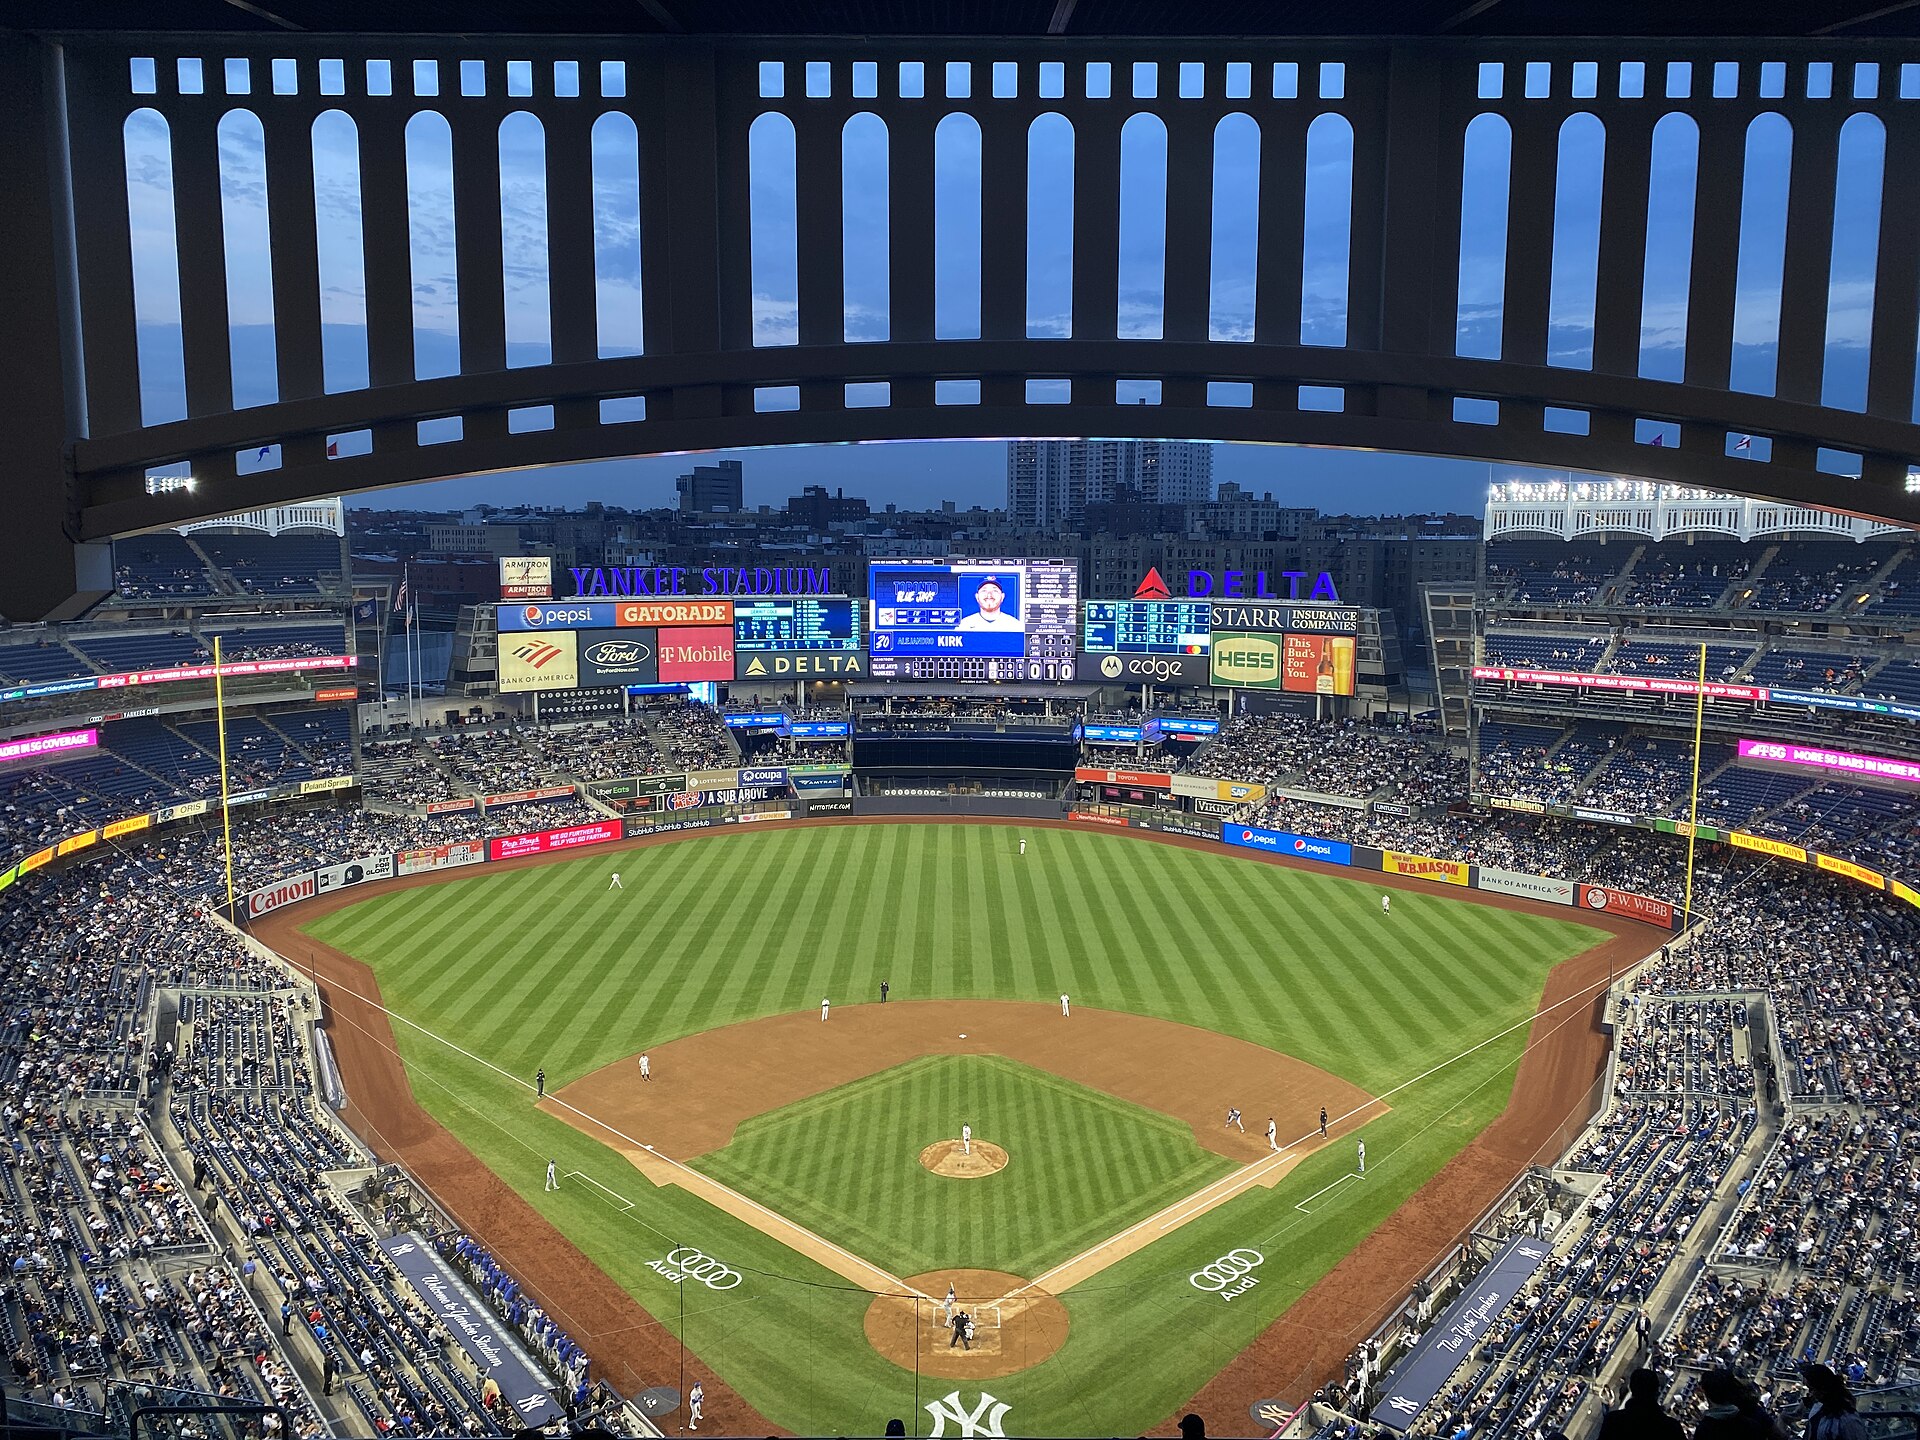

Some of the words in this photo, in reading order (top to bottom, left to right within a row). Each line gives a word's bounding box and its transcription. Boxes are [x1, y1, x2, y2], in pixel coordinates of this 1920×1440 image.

[567, 567, 687, 596] YANKEE
[702, 567, 830, 595] STADIUM
[893, 581, 939, 596] TORONTO
[1188, 570, 1339, 601] DELTA
[896, 591, 915, 602] BLUE
[916, 591, 935, 602] JAYS
[546, 607, 592, 624] pepsi
[624, 605, 726, 623] GATORADE
[1090, 610, 1096, 618] 0
[1106, 610, 1113, 618] 0
[1212, 607, 1284, 628] STARR
[1292, 610, 1358, 622] INSURANCE
[1292, 619, 1357, 630] COMPANIES
[876, 635, 890, 650] 30
[897, 637, 934, 646] ALEJANDRO
[938, 636, 963, 648] KIRK
[1288, 638, 1311, 648] This
[596, 644, 638, 662] Ford
[678, 646, 732, 662] Mobile
[1218, 651, 1274, 669] HESS
[1288, 648, 1316, 658] Bud's
[258, 662, 294, 670] DOWNLOAD
[776, 656, 861, 673] DELTA
[1128, 656, 1182, 682] edge
[1288, 659, 1304, 668] For
[1031, 664, 1040, 678] 0
[1048, 664, 1054, 678] 1
[1062, 664, 1071, 679] 0
[1288, 668, 1309, 678] You.
[500, 676, 524, 684] BANK
[538, 674, 574, 682] AMERICA
[1596, 678, 1618, 686] GREAT
[1620, 680, 1648, 688] OFFERS.
[1650, 682, 1694, 691] DOWNLOAD
[1726, 688, 1753, 696] TODAY.
[123, 710, 146, 718] YANKEES
[146, 708, 159, 716] CLUB
[21, 744, 30, 754] IN
[30, 740, 42, 752] 5G
[42, 734, 88, 750] COVERAGE
[1769, 746, 1786, 758] 5G
[1794, 750, 1824, 763] MORE
[1824, 754, 1838, 764] 5G
[1839, 756, 1864, 769] BARS
[1865, 761, 1876, 771] IN
[1878, 762, 1907, 776] MORE
[754, 770, 782, 780] coupa
[304, 782, 327, 792] Poland
[328, 779, 350, 790] Spring
[596, 788, 612, 796] Uber
[612, 786, 630, 794] Eats
[1231, 788, 1247, 797] SAP
[253, 792, 268, 800] TEA
[674, 791, 699, 801] Jersey
[708, 795, 714, 804] A
[716, 790, 736, 804] SUB
[738, 788, 768, 802] ABOVE
[1159, 792, 1176, 800] FedEx
[180, 803, 200, 814] ORIS
[1198, 800, 1234, 814] VIKING
[1490, 798, 1509, 806] Parts
[1510, 799, 1545, 813] Authority
[1576, 810, 1615, 822] BIGELOW
[1615, 816, 1633, 824] TEA
[569, 828, 594, 838] FURTHER
[628, 826, 654, 836] StubHub
[655, 823, 682, 832] StubHub
[683, 820, 710, 829] StubHub
[1162, 825, 1182, 834] StubHub
[1183, 828, 1201, 836] StubHub
[1202, 832, 1220, 840] StubHub
[502, 840, 518, 848] Pep
[518, 836, 540, 846] Boys
[586, 832, 612, 841] FARTHER
[1254, 835, 1276, 845] pepsi
[1306, 844, 1331, 855] pepsi
[1735, 835, 1752, 846] THE
[1754, 841, 1782, 854] HALAL
[1782, 846, 1803, 859] GUYS
[378, 856, 390, 864] FIT
[1823, 859, 1838, 868] GREAT
[1840, 863, 1852, 872] HALL
[366, 866, 390, 876] GLORY
[1398, 862, 1458, 876] W.B.MASON
[1482, 876, 1502, 886] BANK
[1504, 879, 1514, 887] OF
[1516, 880, 1552, 894] AMERICA
[250, 878, 314, 914] Canon
[1608, 892, 1630, 908] F.W.
[1631, 898, 1668, 917] WEBB
[390, 1243, 415, 1256] NY
[1517, 1246, 1544, 1260] NY
[644, 1260, 688, 1284] Audi
[422, 1274, 450, 1304] Welcome
[1220, 1275, 1260, 1302] Audi
[444, 1302, 458, 1310] to
[440, 1306, 482, 1336] Yankee
[1436, 1334, 1464, 1352] New
[1450, 1314, 1478, 1340] York
[1466, 1292, 1500, 1324] Yankees
[471, 1334, 502, 1367] Stadium
[516, 1394, 548, 1412] NY
[1388, 1396, 1420, 1416] NY
[924, 1390, 1013, 1439] NY
[1258, 1404, 1295, 1426] NY
